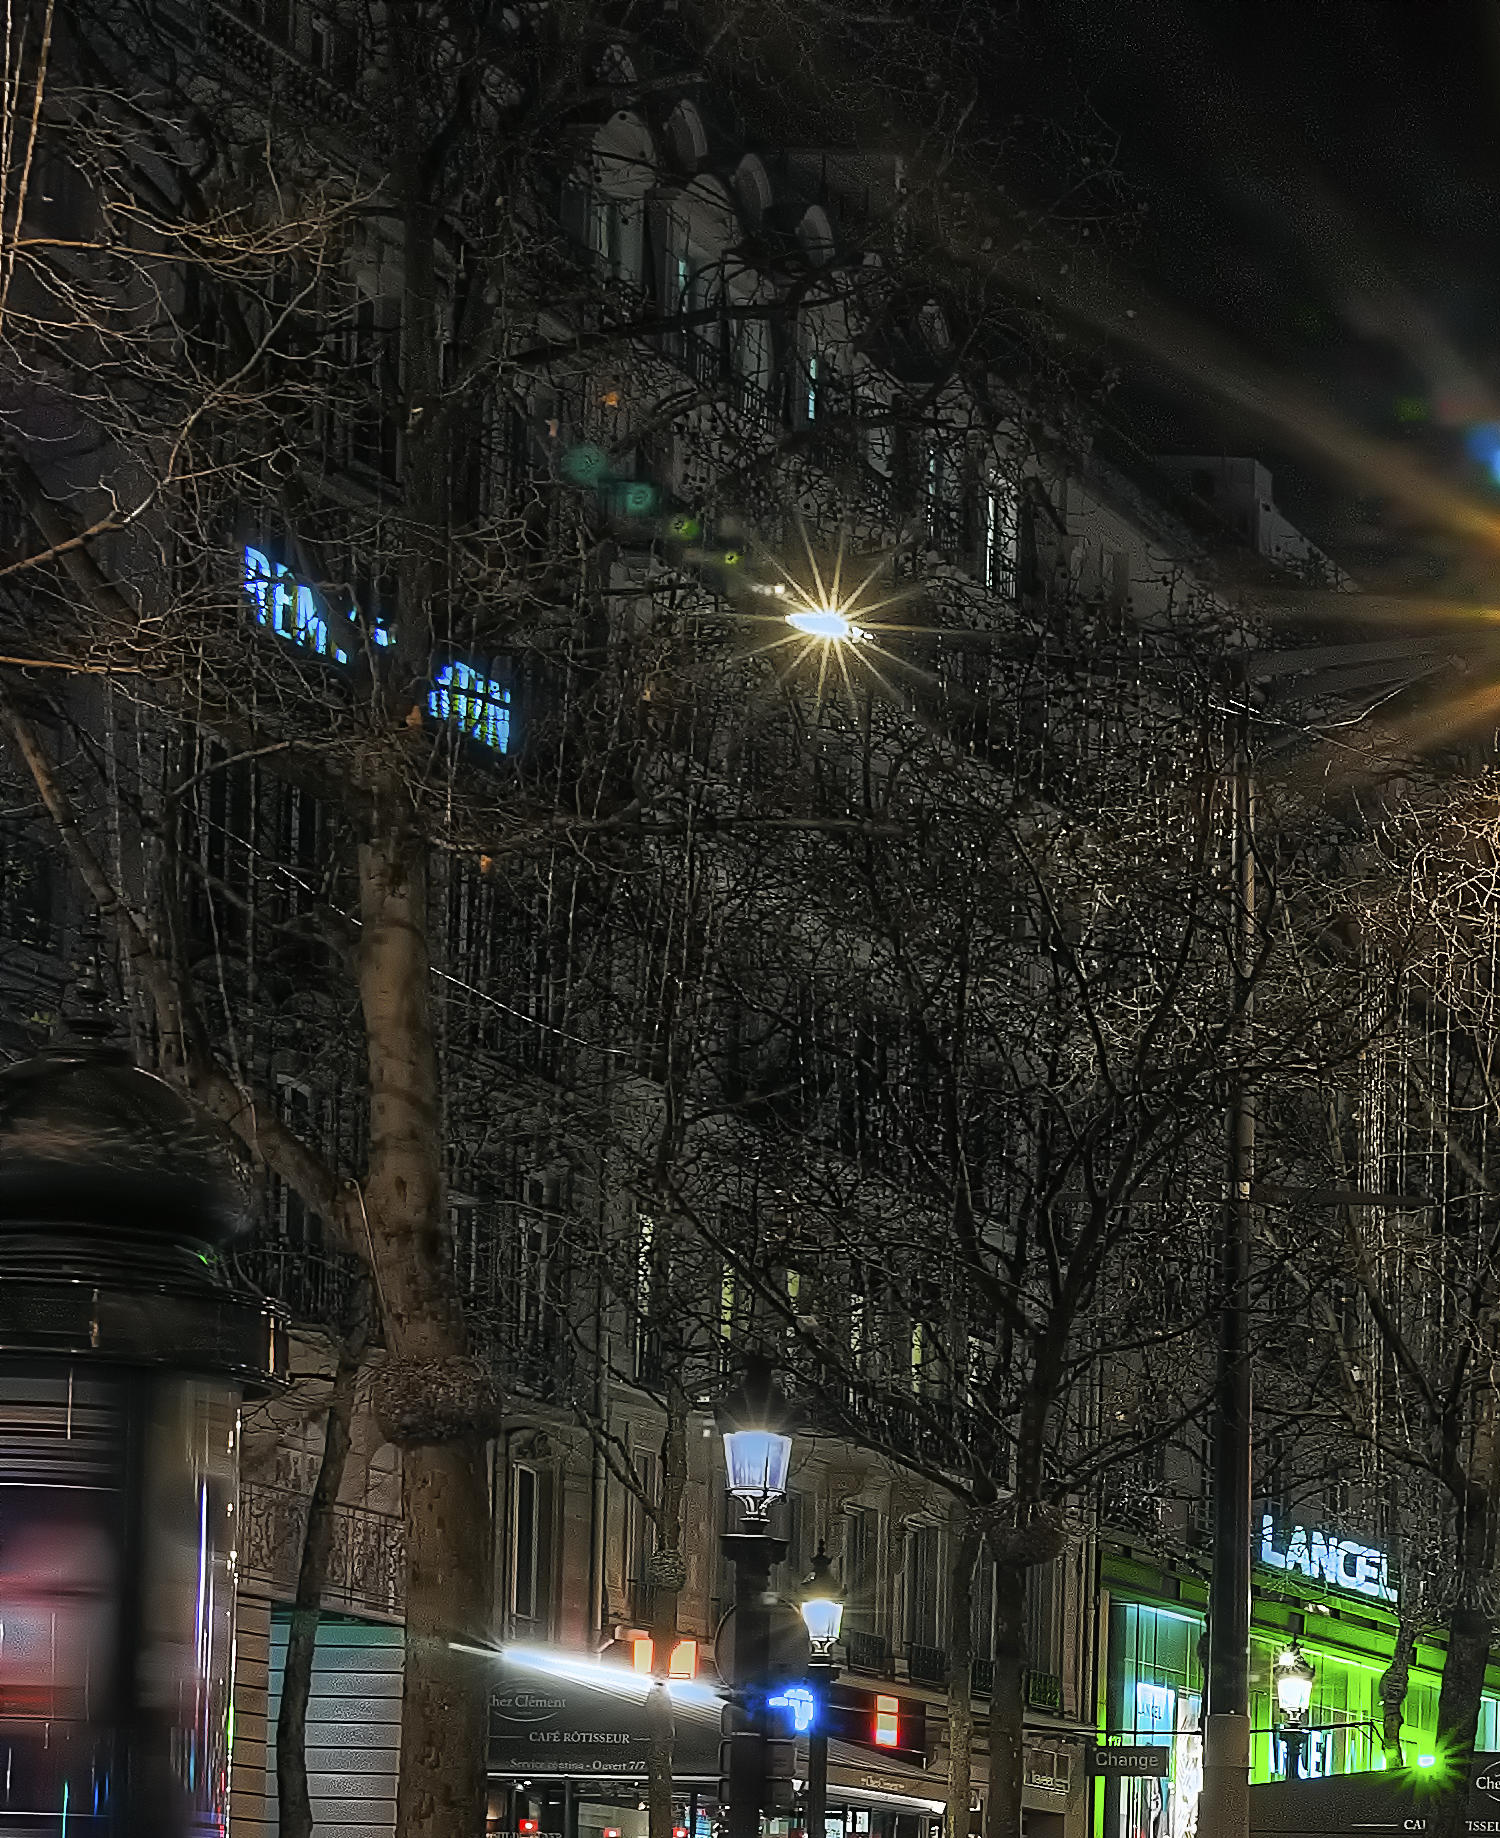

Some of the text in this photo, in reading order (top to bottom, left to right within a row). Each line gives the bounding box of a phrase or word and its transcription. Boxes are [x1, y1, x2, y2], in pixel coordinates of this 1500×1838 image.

[1261, 1513, 1399, 1603] LANCEL
[488, 1694, 567, 1708] hez Clément
[529, 1730, 631, 1745] CAFÉ RÔTISSEUR
[510, 1758, 545, 1770] Service
[629, 1761, 646, 1771] 7/7
[1095, 1751, 1160, 1771] Change
